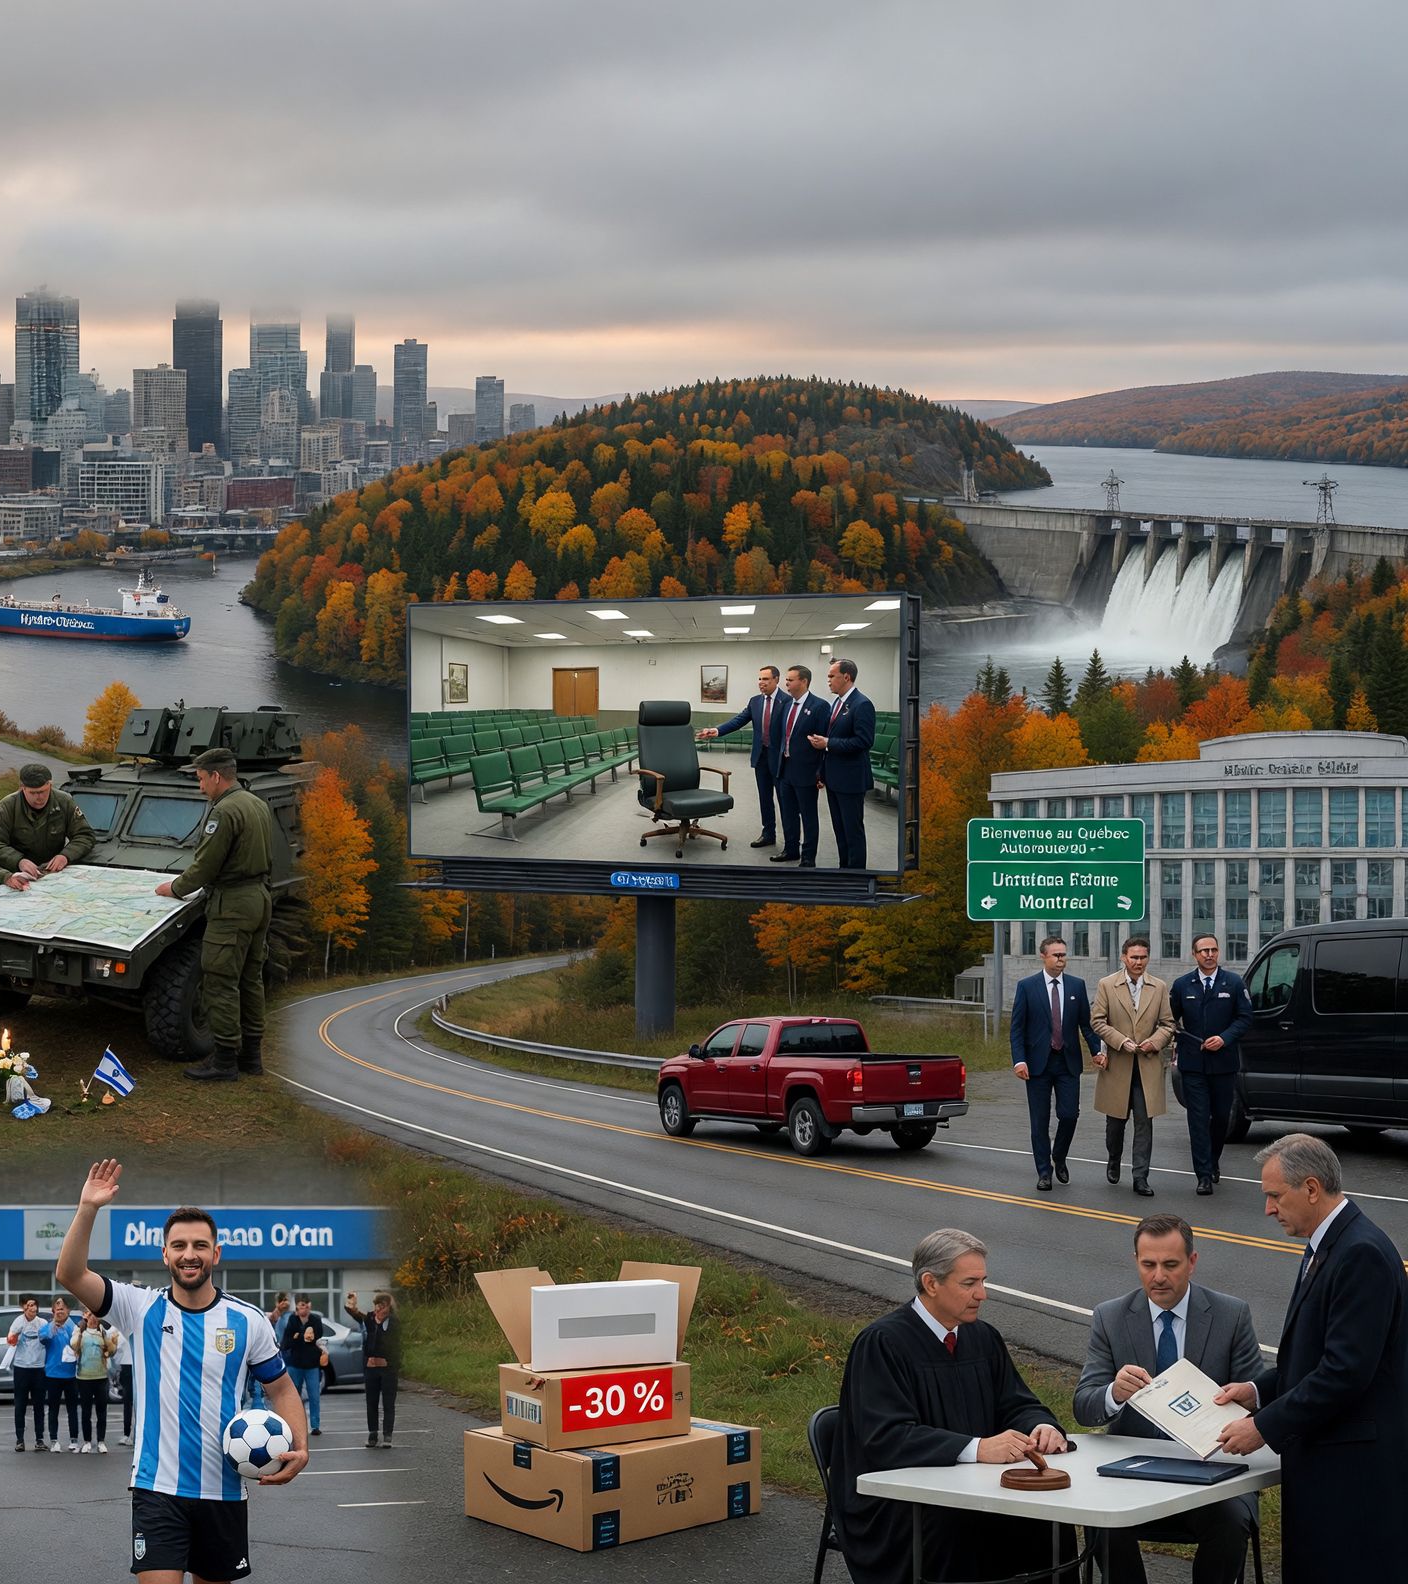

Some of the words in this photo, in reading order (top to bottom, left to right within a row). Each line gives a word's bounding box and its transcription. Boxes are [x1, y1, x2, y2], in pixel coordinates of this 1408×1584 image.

[981, 826, 1053, 840] Bienvenue
[1056, 829, 1073, 839] au
[1077, 825, 1130, 841] Québec
[569, 1384, 626, 1419] -30
[633, 1380, 665, 1414] %
